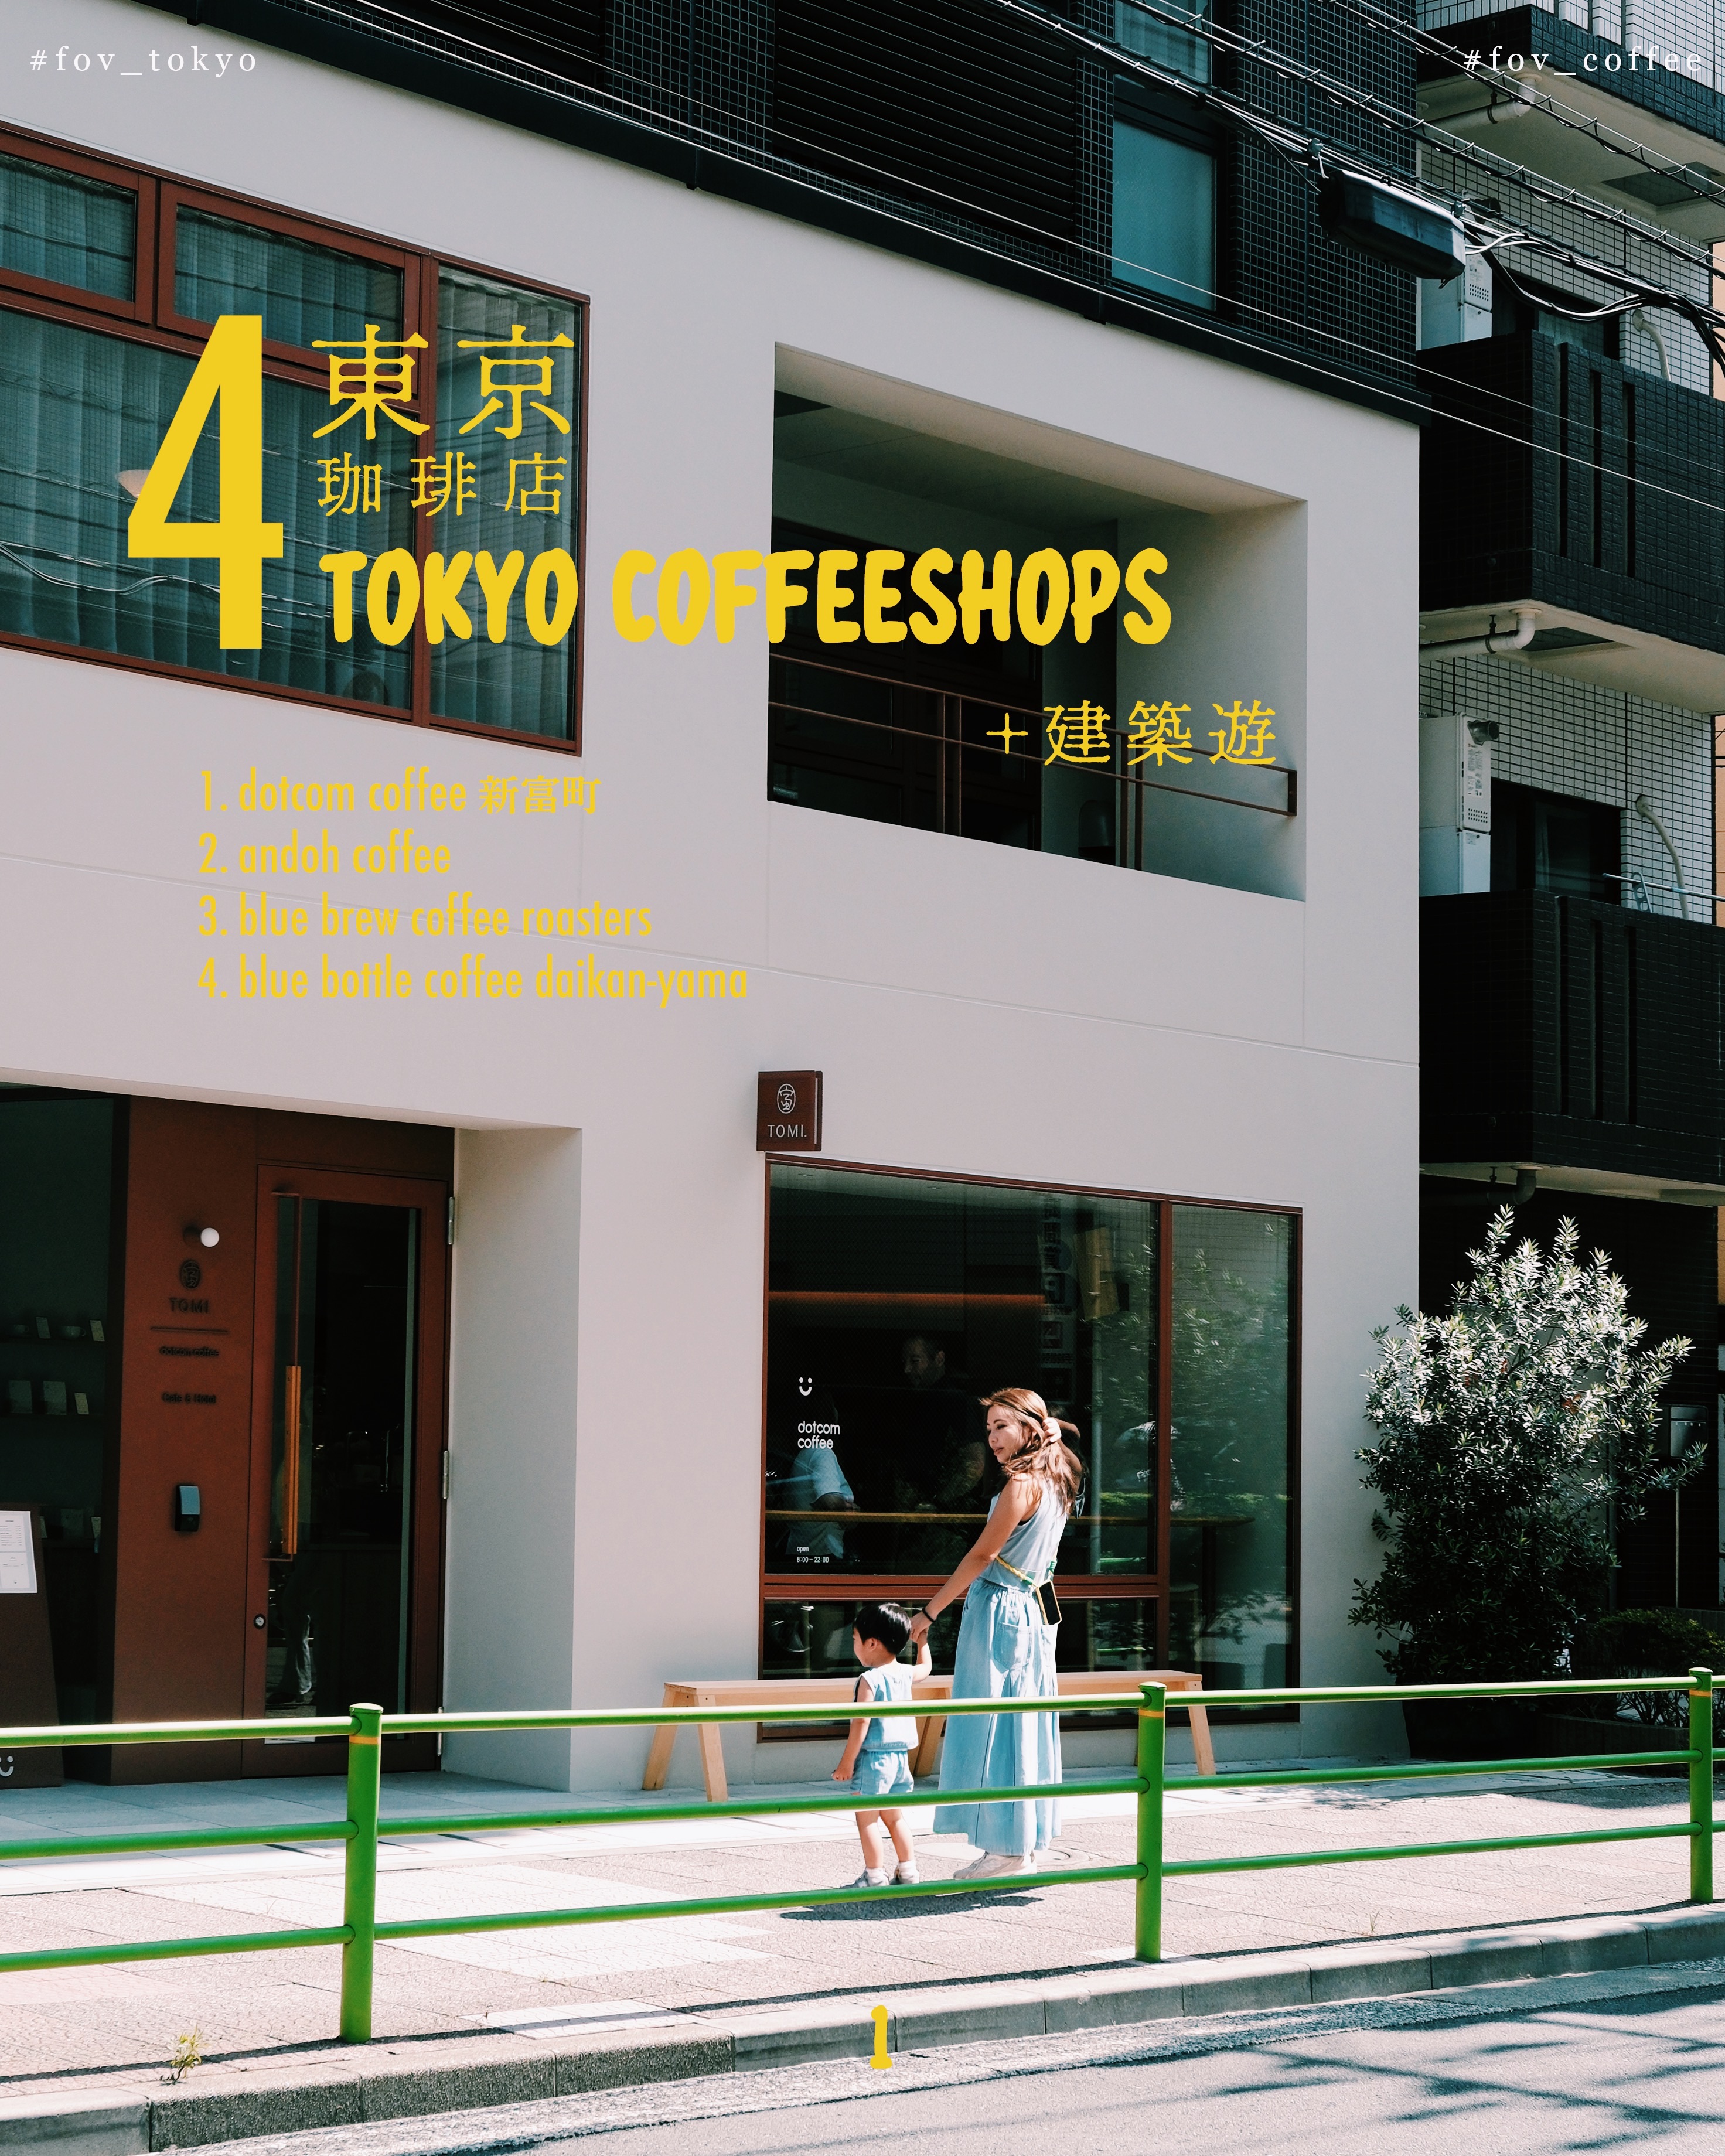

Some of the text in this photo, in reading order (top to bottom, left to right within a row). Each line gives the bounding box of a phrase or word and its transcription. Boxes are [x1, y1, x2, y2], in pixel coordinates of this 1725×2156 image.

[767, 1124, 807, 1138] TOMI.
[169, 1297, 209, 1314] TOMI
[797, 1420, 840, 1435] dotcom
[797, 1435, 834, 1449] coffee
